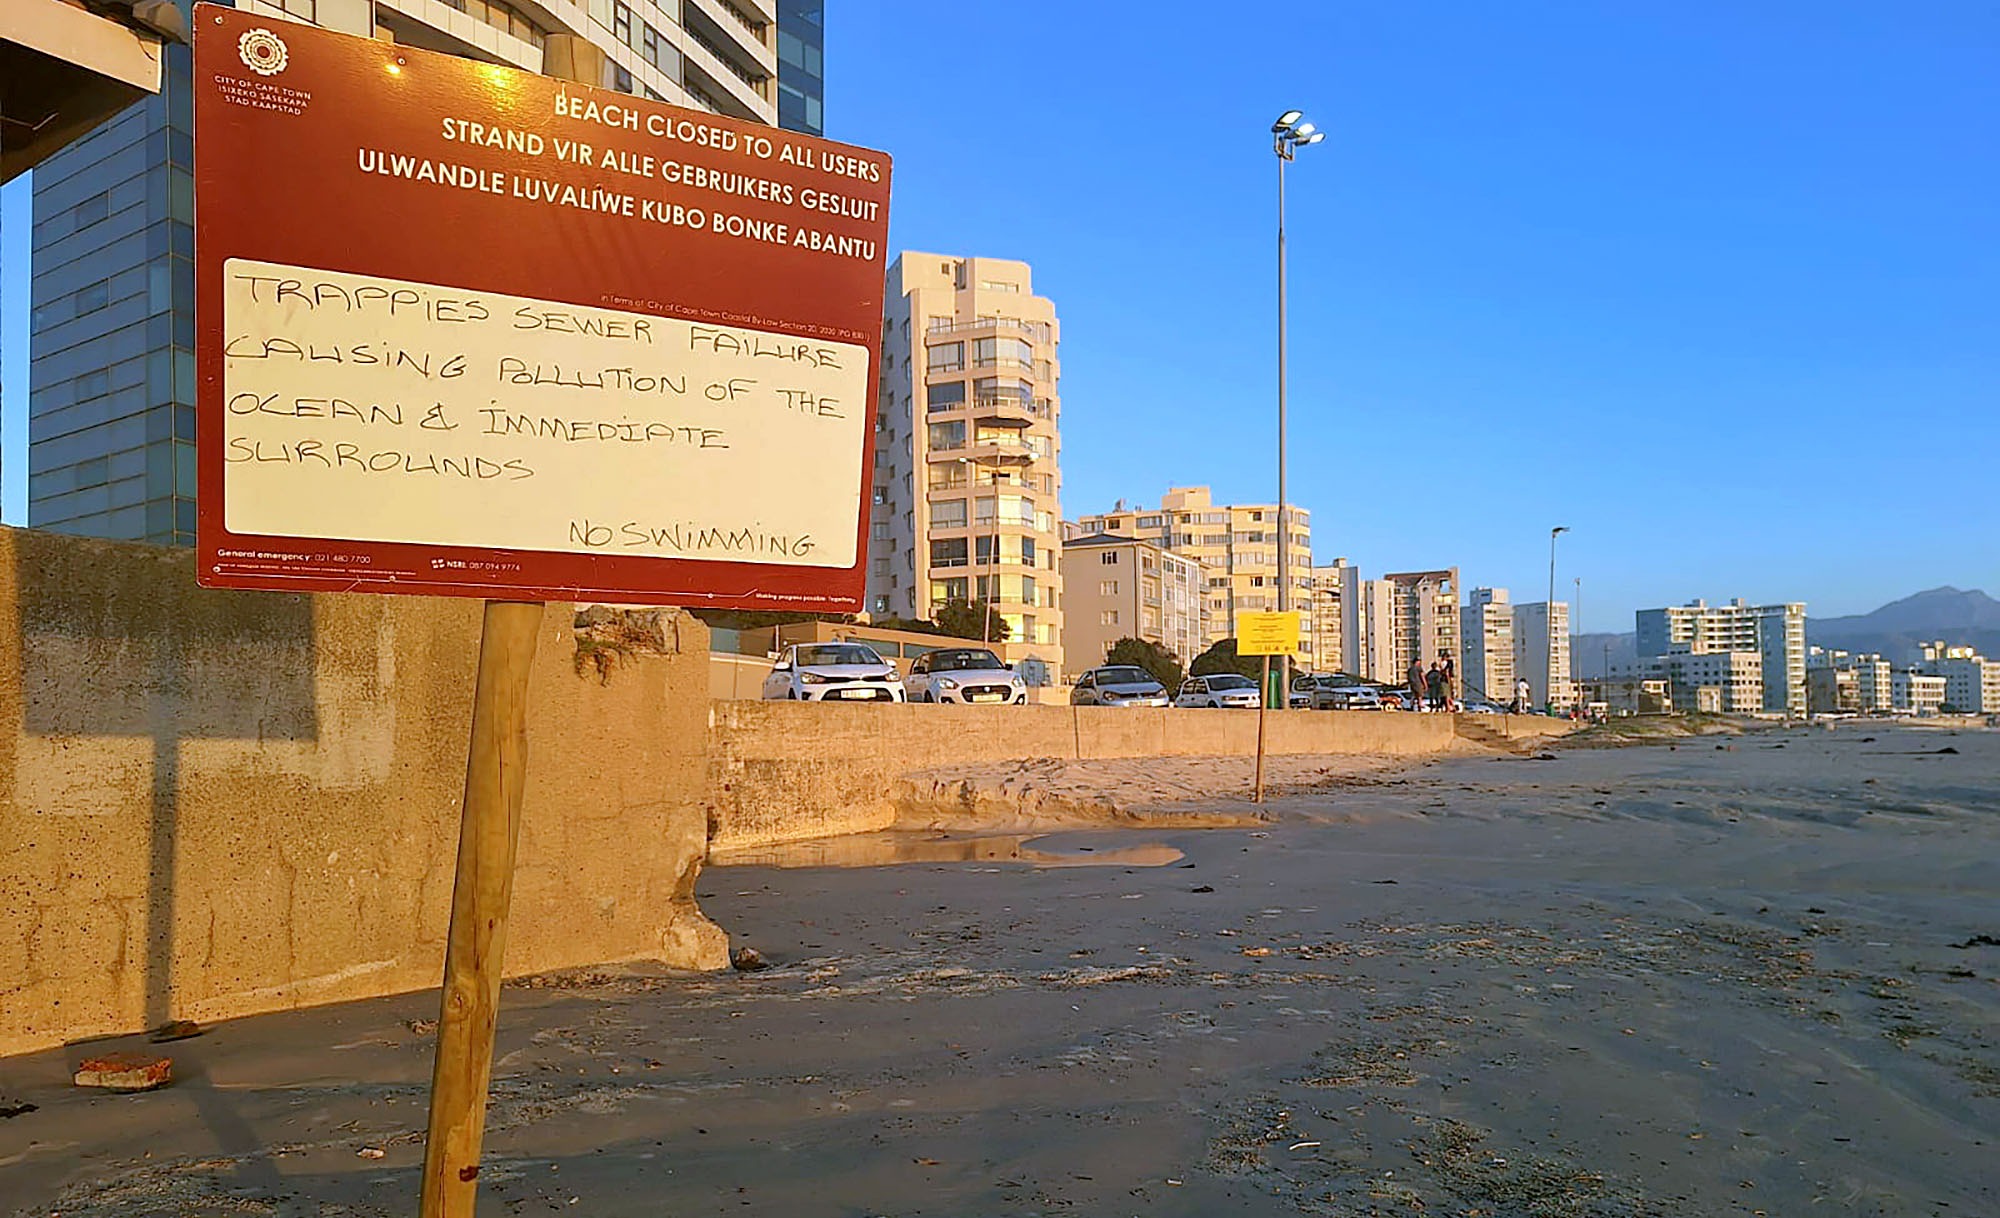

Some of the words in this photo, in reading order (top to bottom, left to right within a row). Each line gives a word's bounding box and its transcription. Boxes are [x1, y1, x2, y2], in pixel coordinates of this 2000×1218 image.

[215, 75, 236, 85] CITY
[239, 79, 252, 88] OF
[255, 83, 280, 94] CAPE
[282, 87, 311, 100] TOWN
[218, 85, 257, 98] ISIXEKO
[260, 92, 307, 108] SASEKAPA
[225, 95, 249, 106] STAD
[252, 100, 301, 115] KAAPSTAD
[554, 95, 639, 131] BEACH
[646, 113, 738, 151] CLOSED
[743, 134, 773, 160] TO
[778, 143, 815, 169] ALL
[822, 151, 881, 183] USERS
[441, 116, 545, 156] STRAND
[552, 137, 593, 166] VIR
[600, 149, 655, 178] ALLE
[661, 160, 794, 206] GEBRUIKERS
[800, 187, 879, 222] GESLUIT
[358, 148, 505, 195] ULWANDLE
[641, 199, 706, 230] KUBO
[712, 213, 788, 245] BONKE
[793, 227, 876, 261] ABANTU
[513, 307, 653, 344] SEWER
[647, 300, 663, 311] City
[675, 304, 698, 316] Cape
[700, 308, 720, 318] Town
[704, 378, 758, 401] OF
[775, 389, 846, 419] THE
[228, 393, 404, 426] OCEAN
[419, 402, 459, 431] &
[478, 400, 730, 449] IMMEDIATE
[225, 437, 535, 481] SURROUNDS
[569, 519, 613, 547] NO
[217, 549, 256, 558] General
[314, 554, 329, 562] 021
[333, 555, 348, 563] 480
[350, 556, 370, 564] 7700
